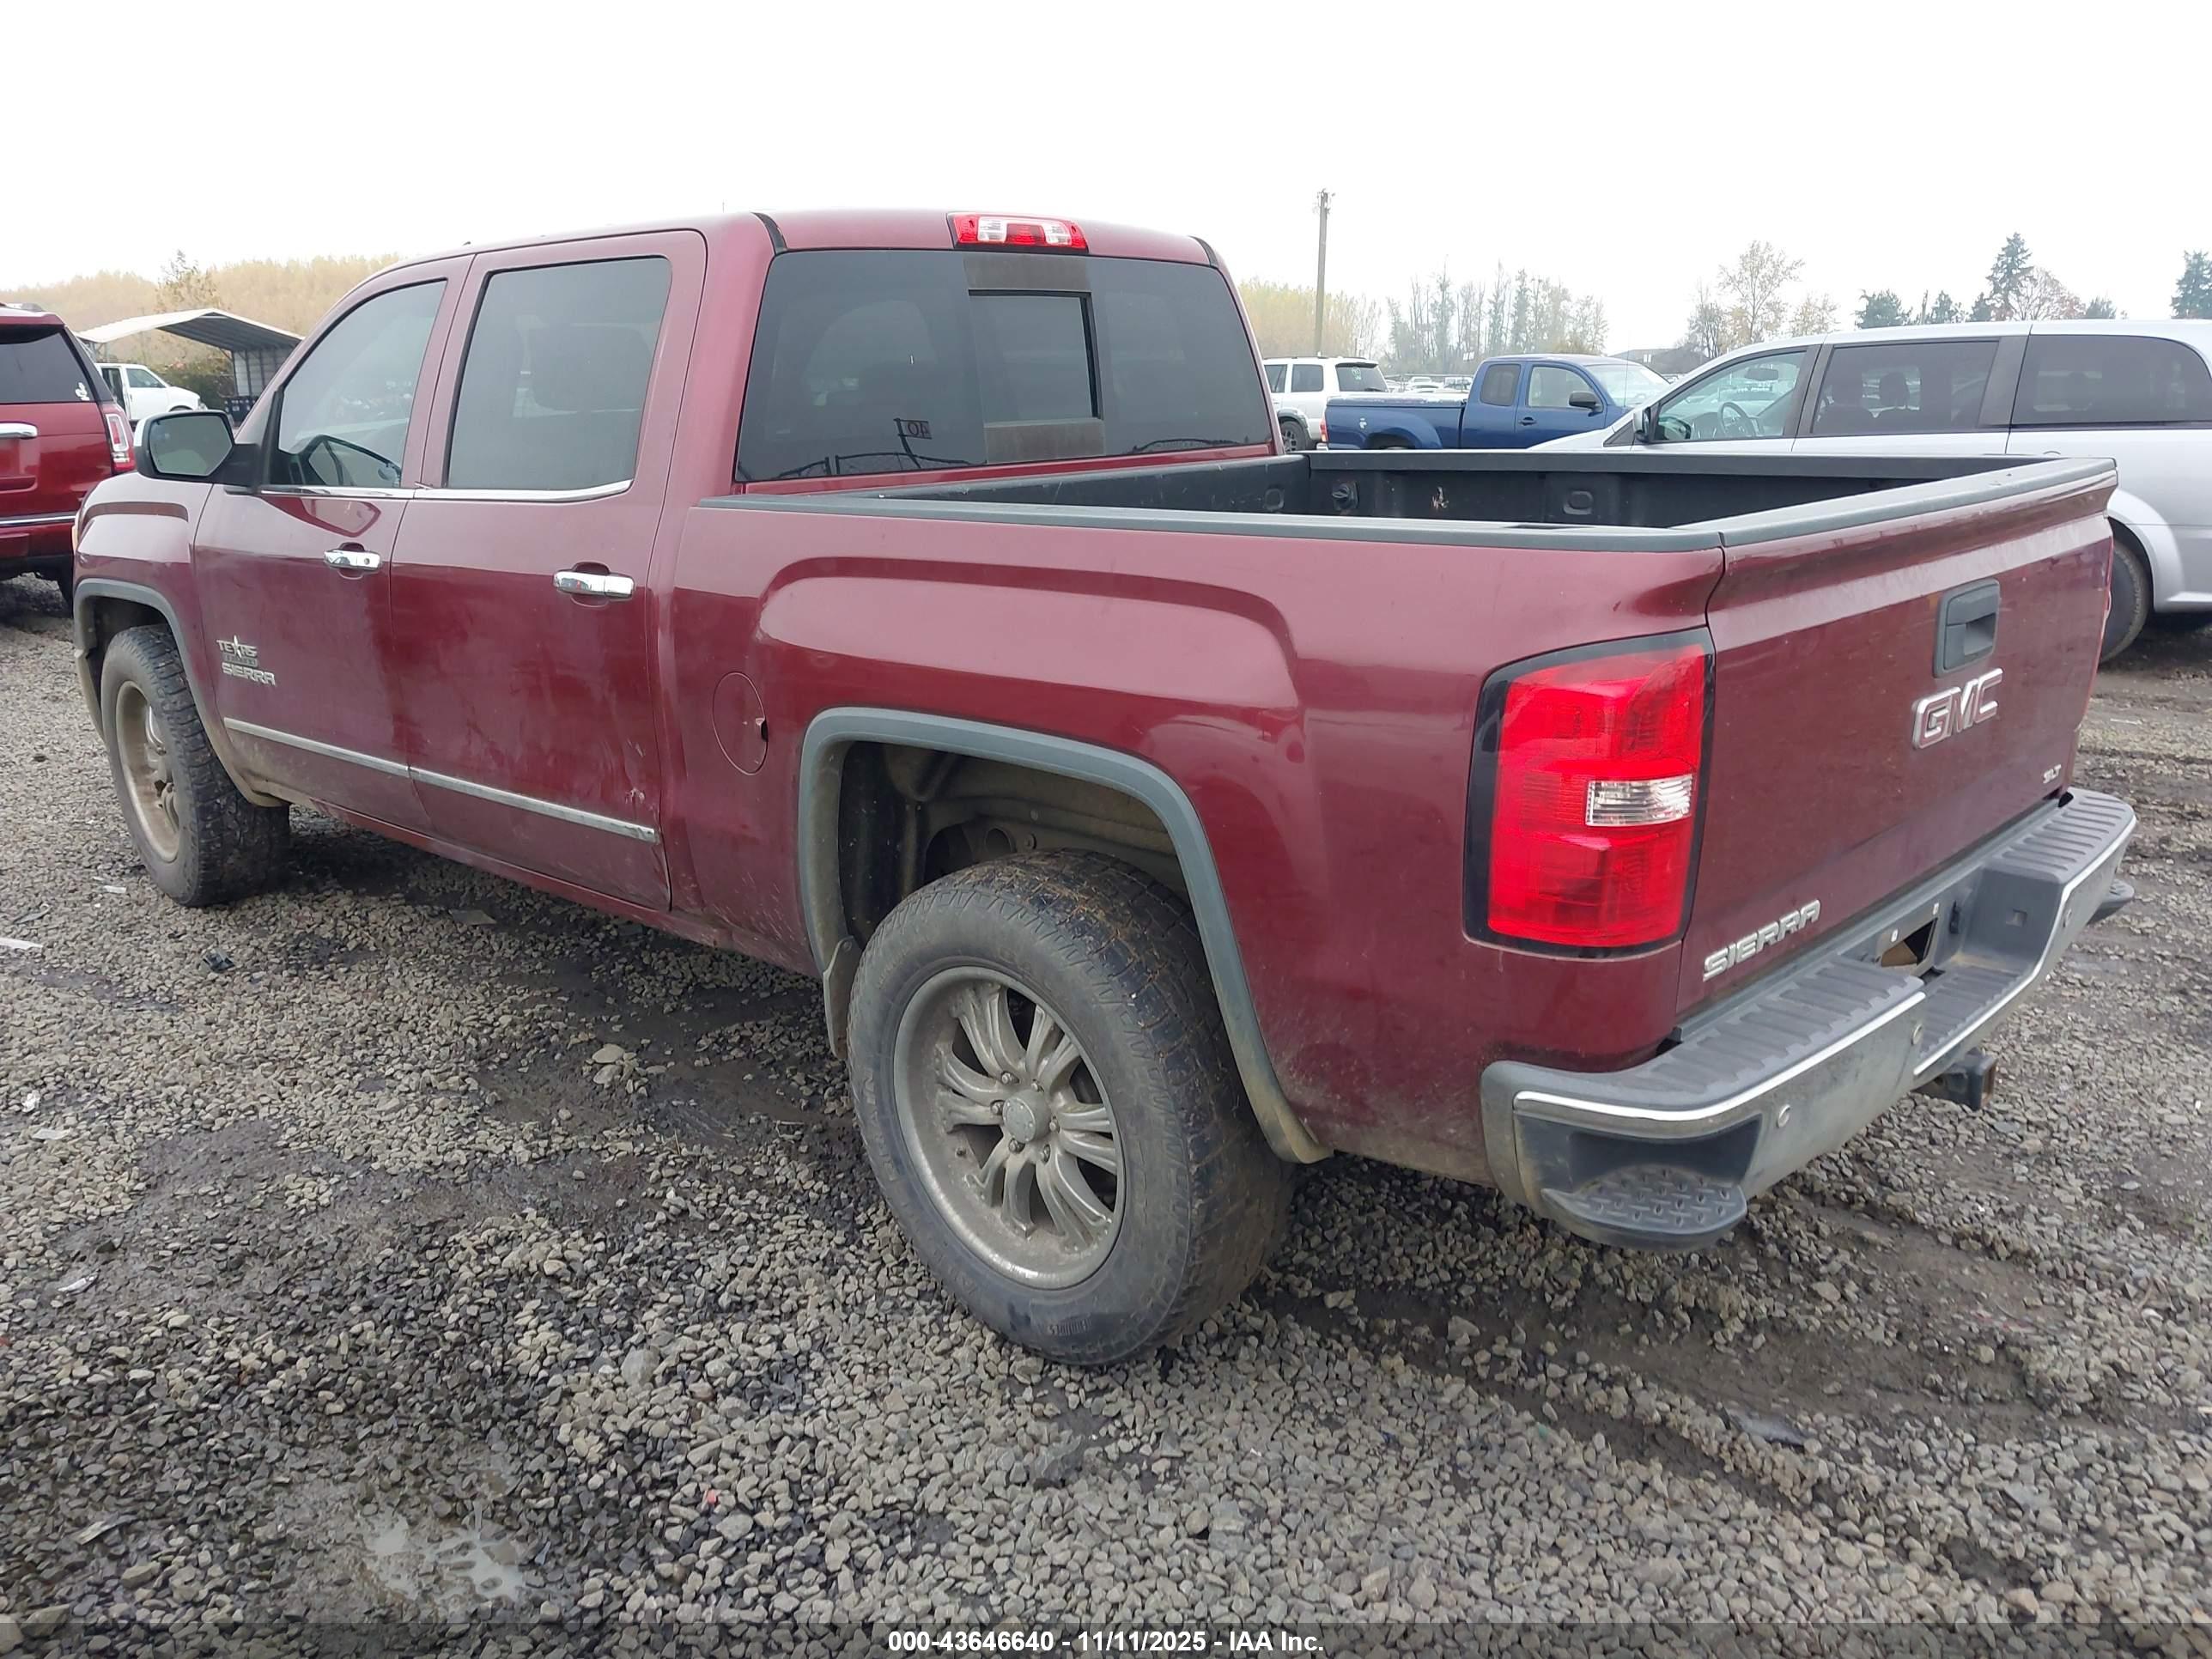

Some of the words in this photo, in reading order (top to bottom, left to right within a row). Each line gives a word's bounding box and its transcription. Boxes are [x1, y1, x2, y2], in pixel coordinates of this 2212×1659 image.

[216, 635, 258, 658] TEXAS
[222, 662, 276, 686] SIERRA
[1911, 667, 2004, 750] GMC
[2043, 764, 2062, 784] SLT
[1702, 899, 1821, 982] SIERRA
